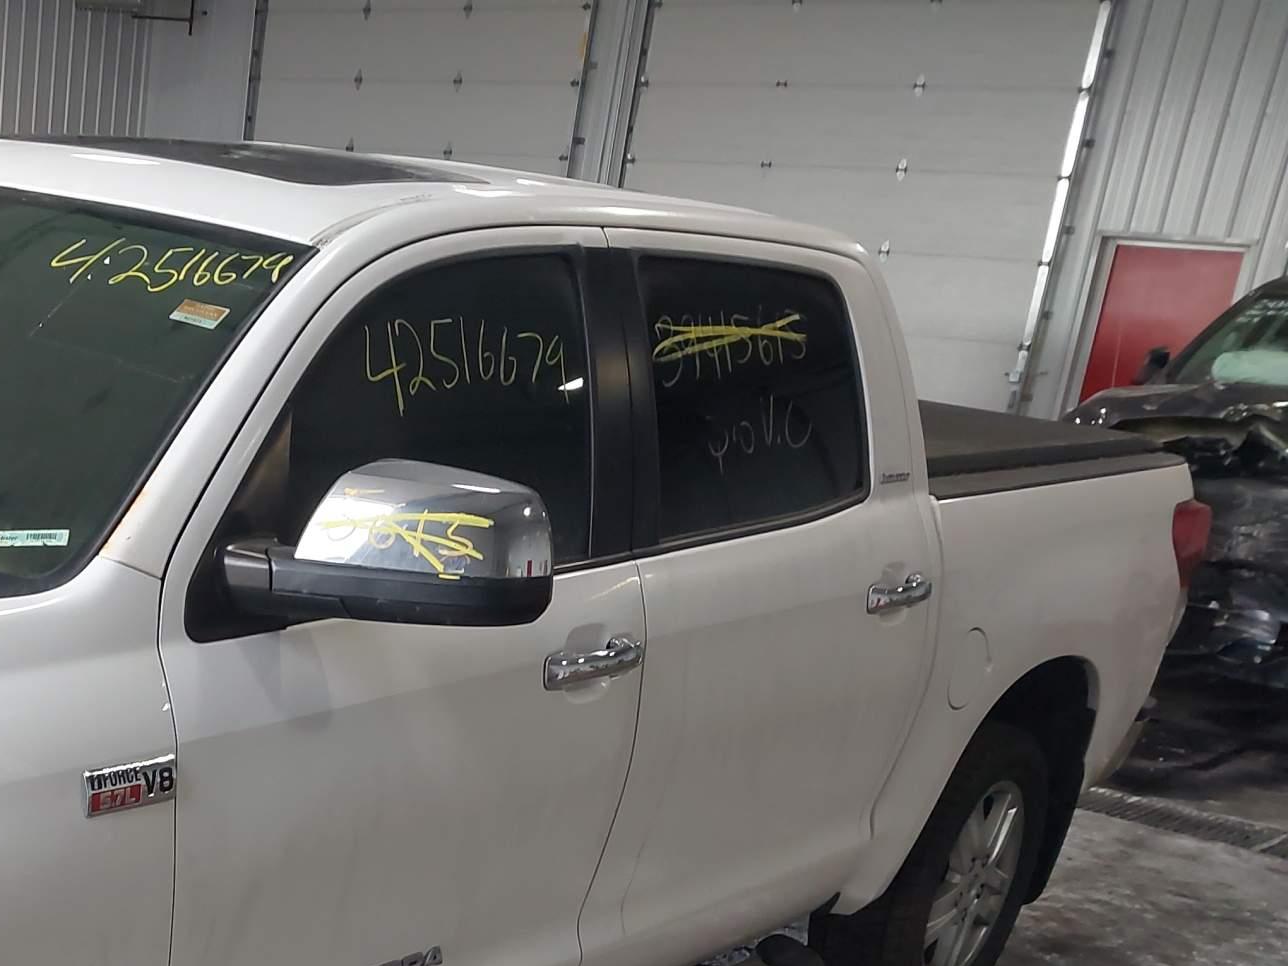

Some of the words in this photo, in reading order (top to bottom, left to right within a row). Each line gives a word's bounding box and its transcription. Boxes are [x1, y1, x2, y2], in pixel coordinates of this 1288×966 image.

[50, 237, 294, 292] 42516679
[364, 315, 570, 417] 42516679
[142, 764, 175, 797] V8
